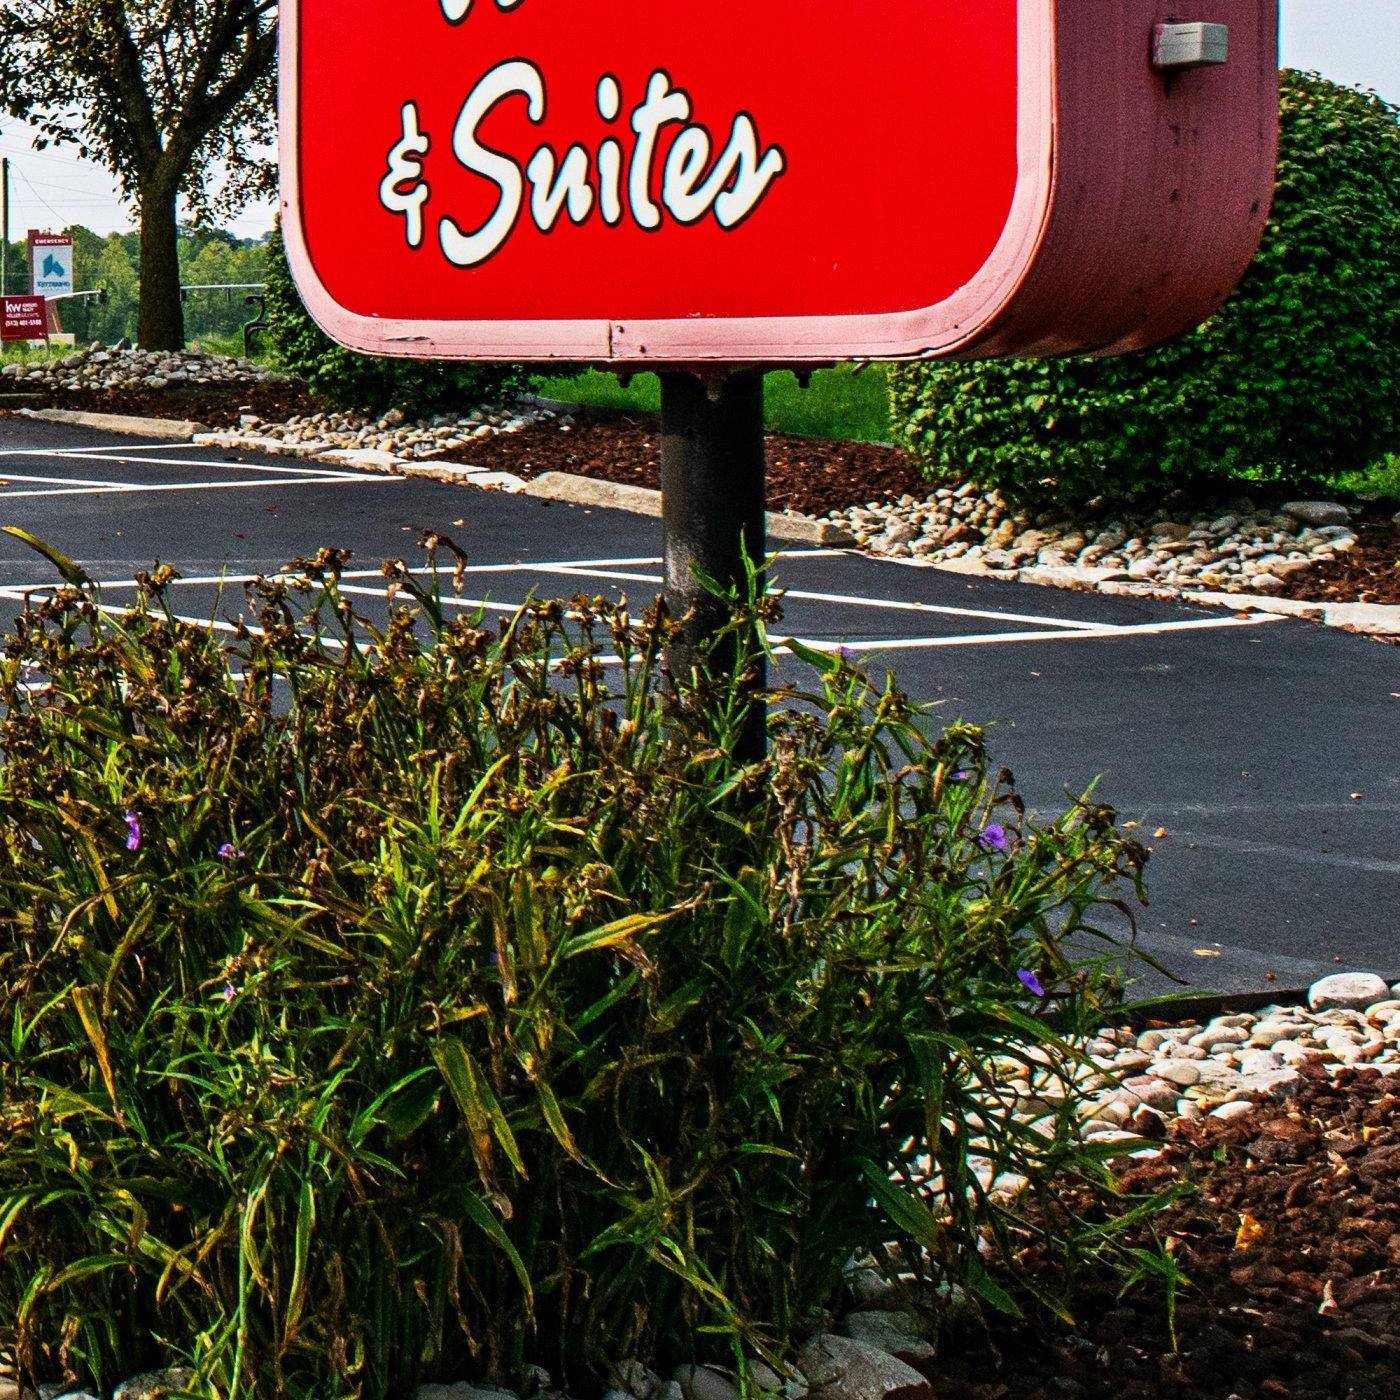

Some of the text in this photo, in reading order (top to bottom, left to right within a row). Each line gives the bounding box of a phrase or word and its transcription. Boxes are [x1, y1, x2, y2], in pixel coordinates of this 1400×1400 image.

[378, 56, 788, 270] & Suites
[5, 300, 21, 313] kw
